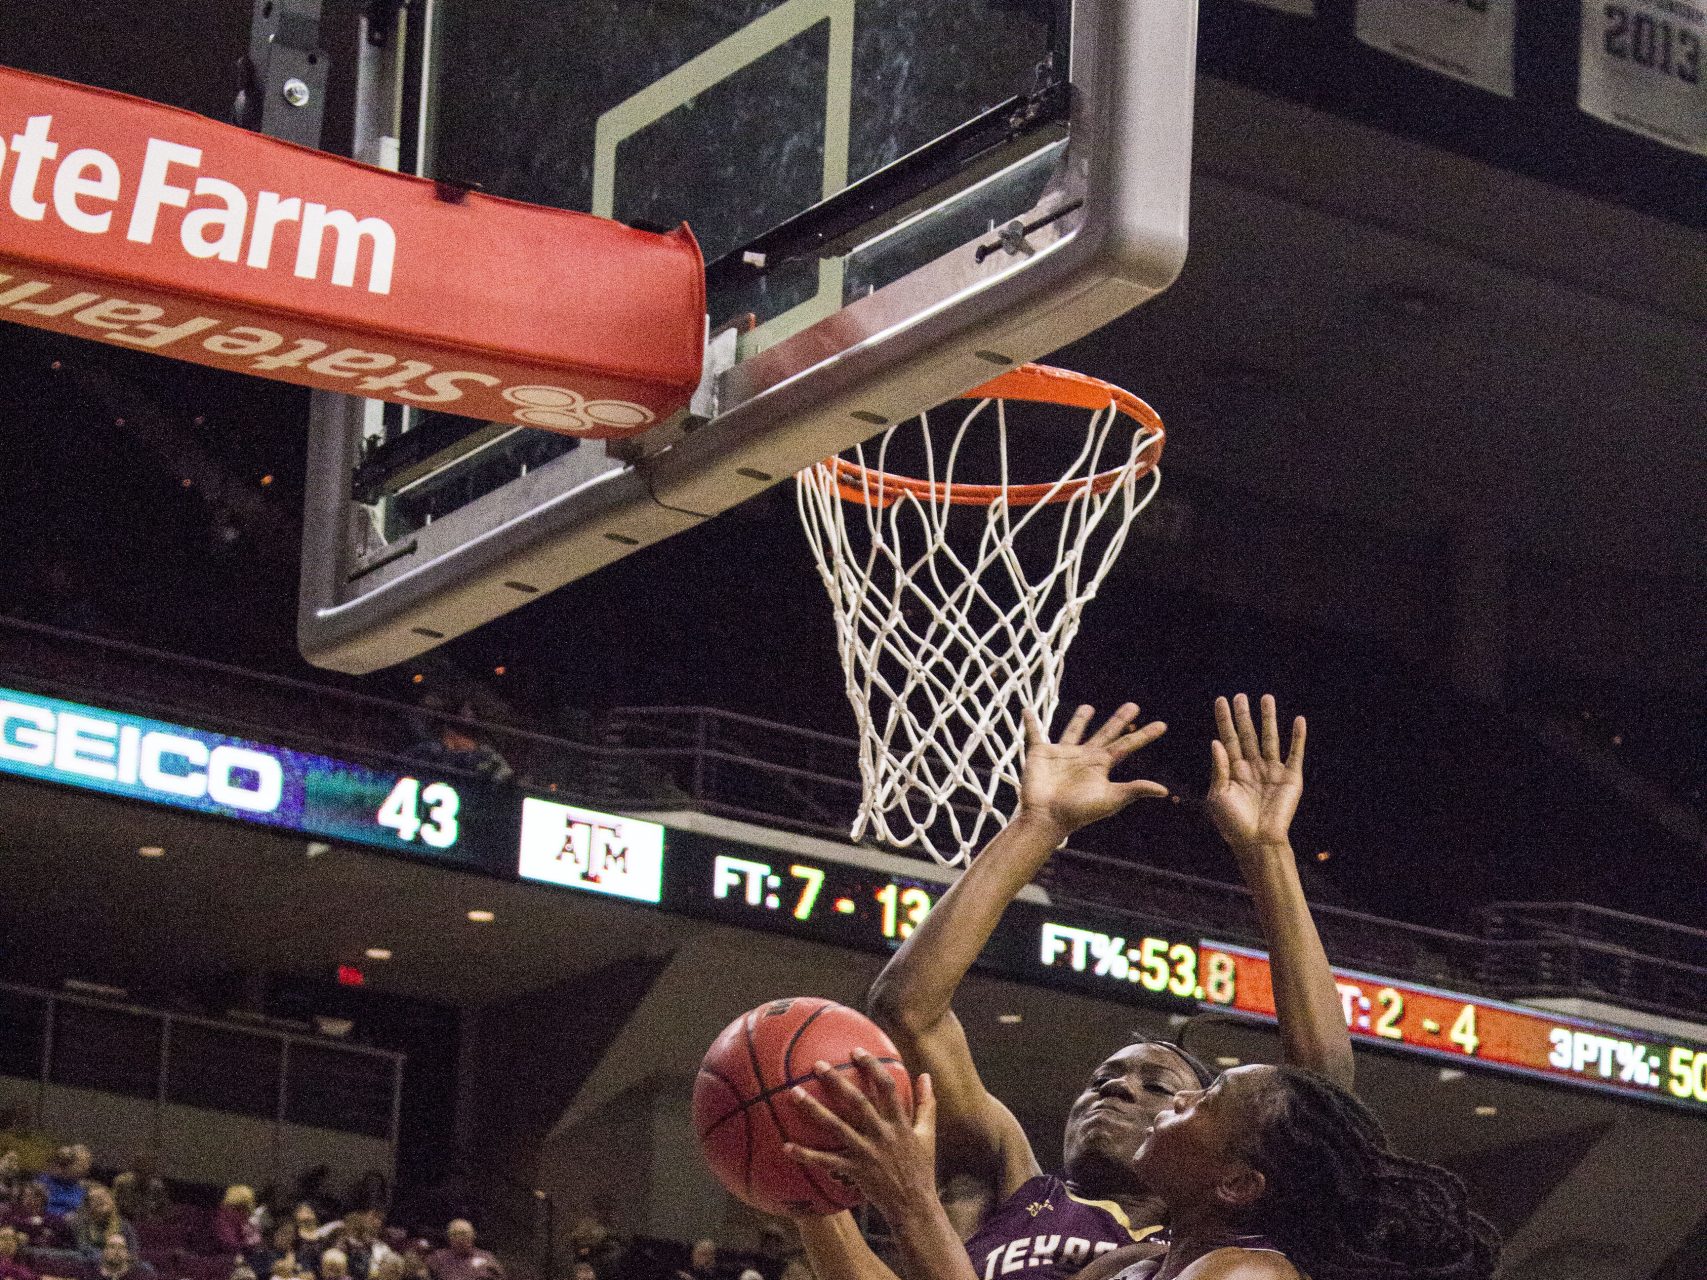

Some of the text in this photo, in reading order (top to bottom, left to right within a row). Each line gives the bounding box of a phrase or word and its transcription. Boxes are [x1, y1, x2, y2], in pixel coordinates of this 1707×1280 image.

[1, 702, 283, 812] GEICO
[377, 777, 460, 848] 43
[714, 855, 782, 909] FT:
[790, 865, 825, 920] 7
[1376, 987, 1404, 1039] 2
[1450, 1004, 1480, 1055] 4
[1549, 1027, 1660, 1087] 3PT%:
